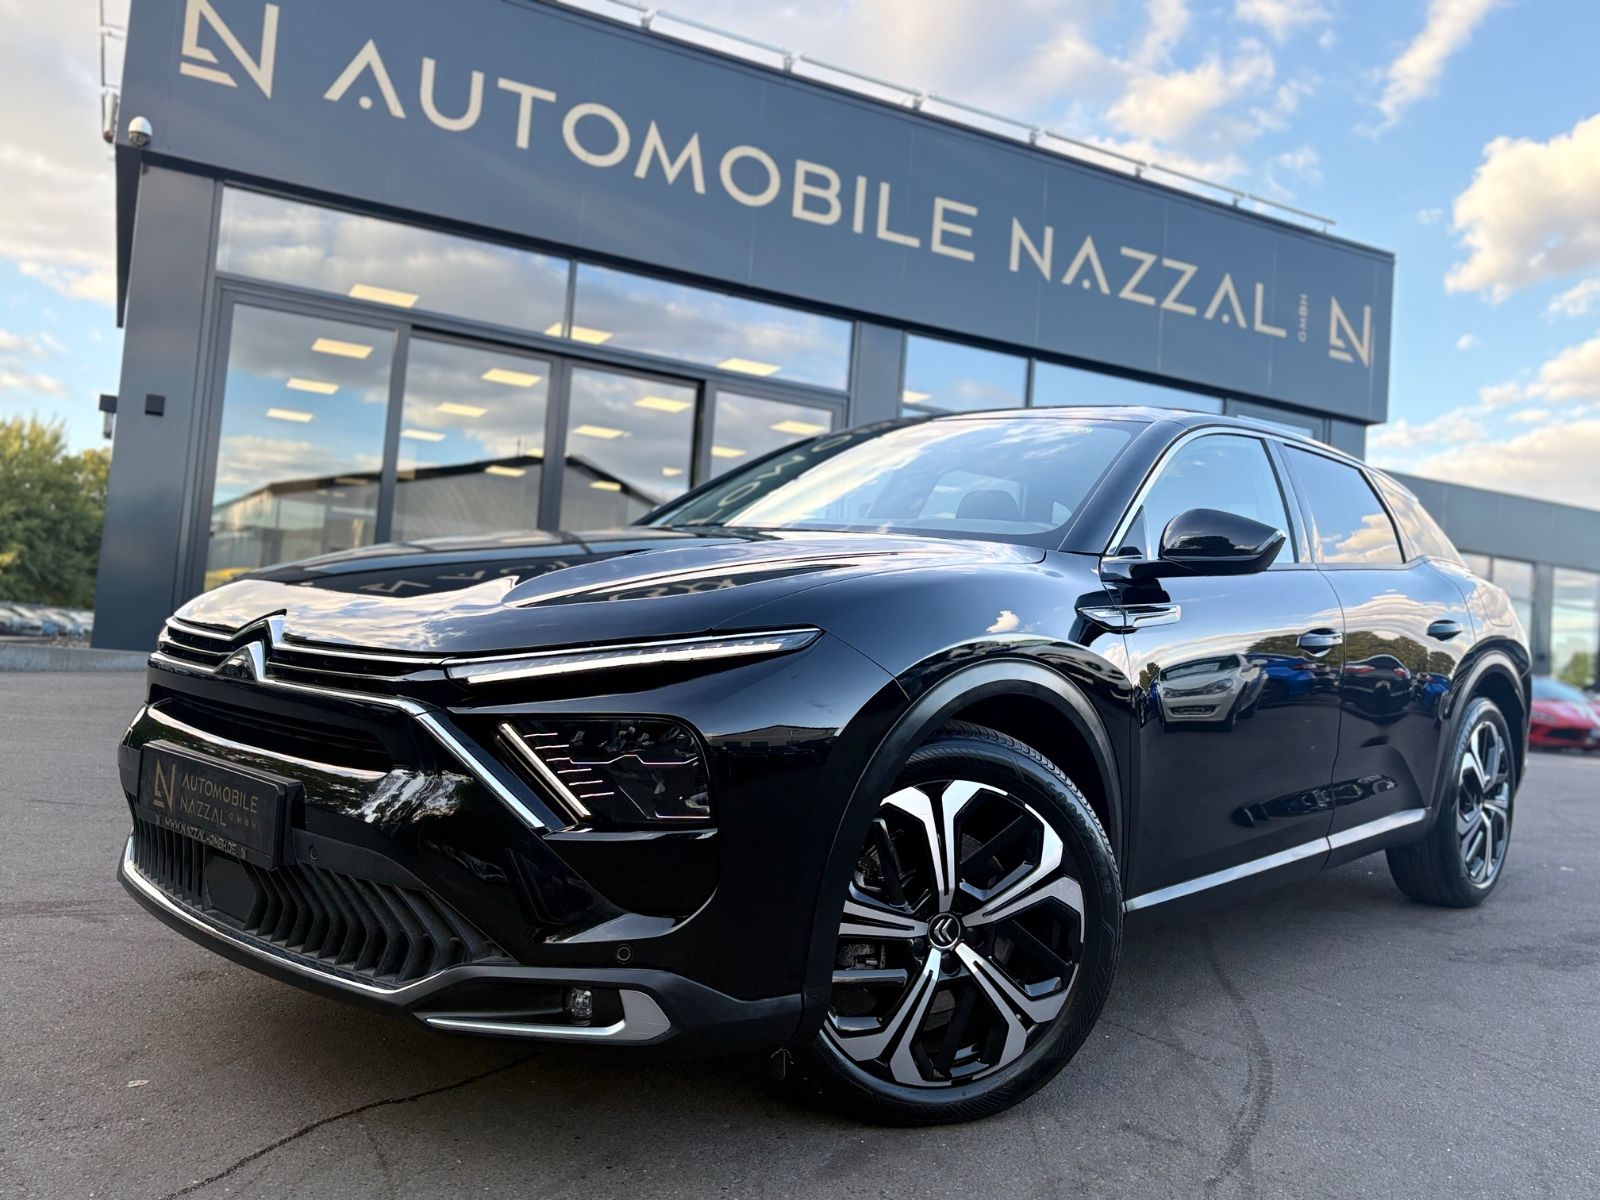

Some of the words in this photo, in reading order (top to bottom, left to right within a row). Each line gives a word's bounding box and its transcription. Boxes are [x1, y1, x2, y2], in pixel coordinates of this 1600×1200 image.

[323, 39, 979, 262] AUTOMOBILE
[1009, 217, 1287, 339] NAZZAL
[180, 797, 227, 826] NAZZAL
[182, 773, 259, 812] AUTOMOBILE
